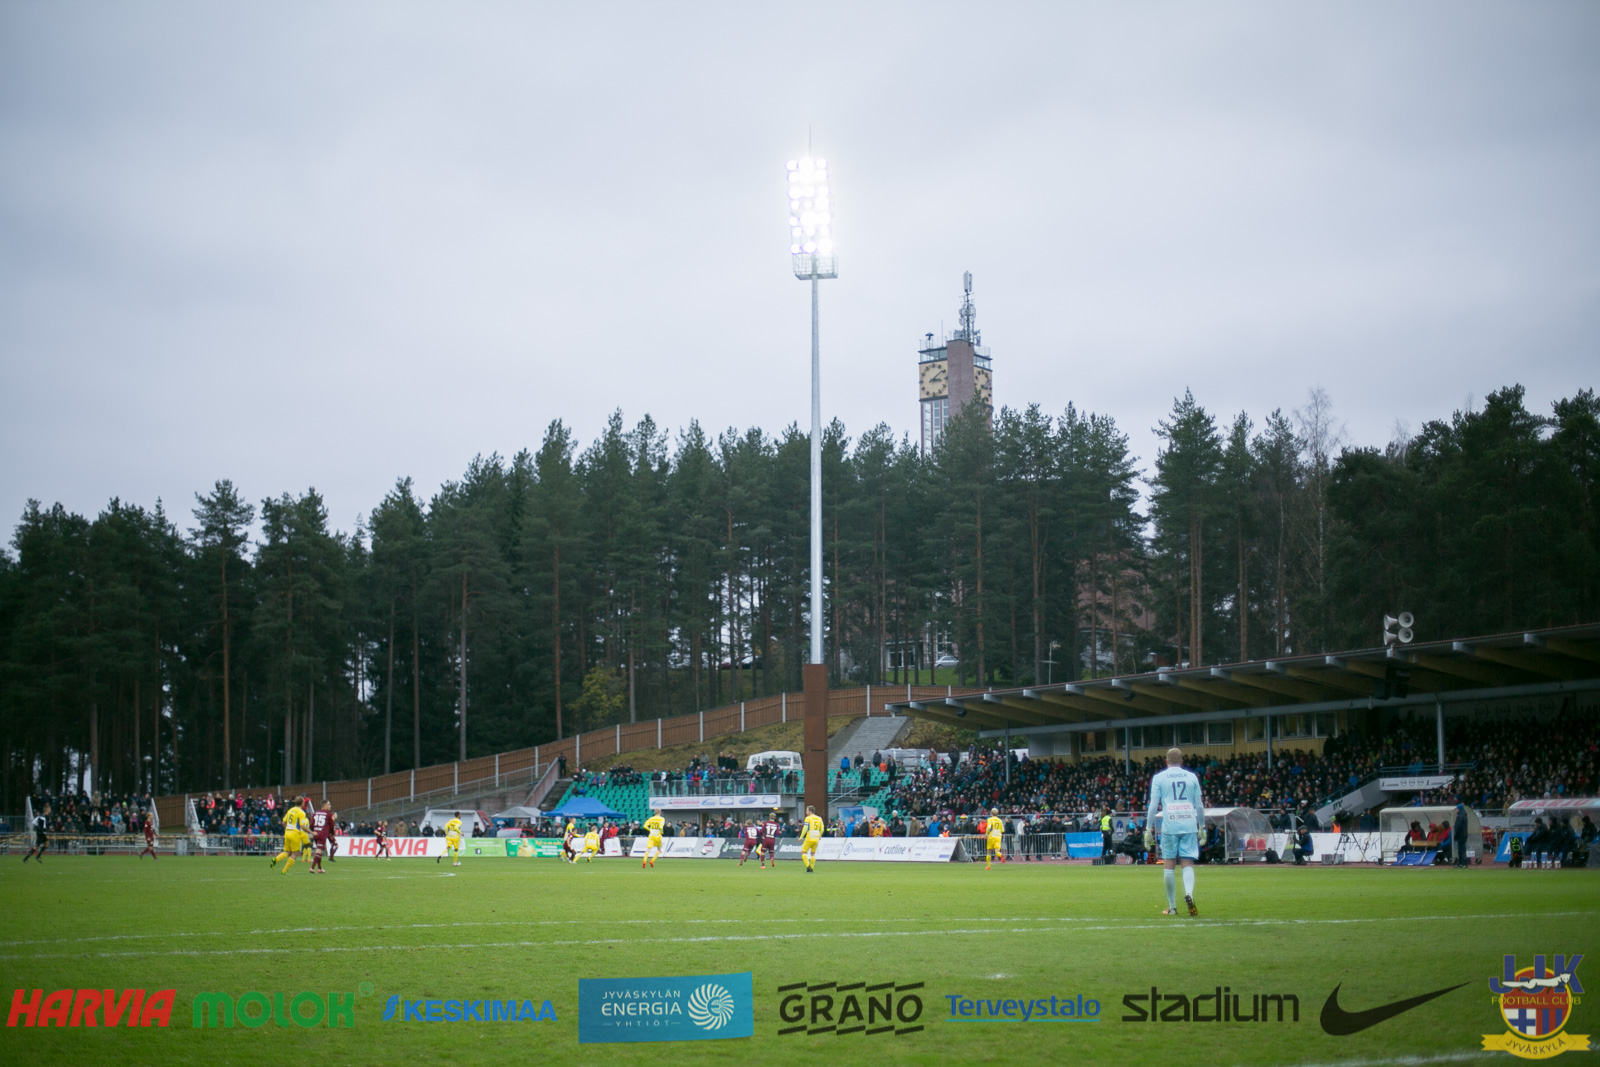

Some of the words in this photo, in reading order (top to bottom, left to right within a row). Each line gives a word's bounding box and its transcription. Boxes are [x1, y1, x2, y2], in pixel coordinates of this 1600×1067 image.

[1171, 781, 1187, 800] 12
[313, 814, 326, 826] 15
[651, 821, 659, 830] 20
[766, 825, 777, 835] 17
[813, 821, 818, 830] 5
[746, 827, 757, 836] 19
[348, 838, 428, 855] HARVIA
[884, 844, 907, 854] cutline
